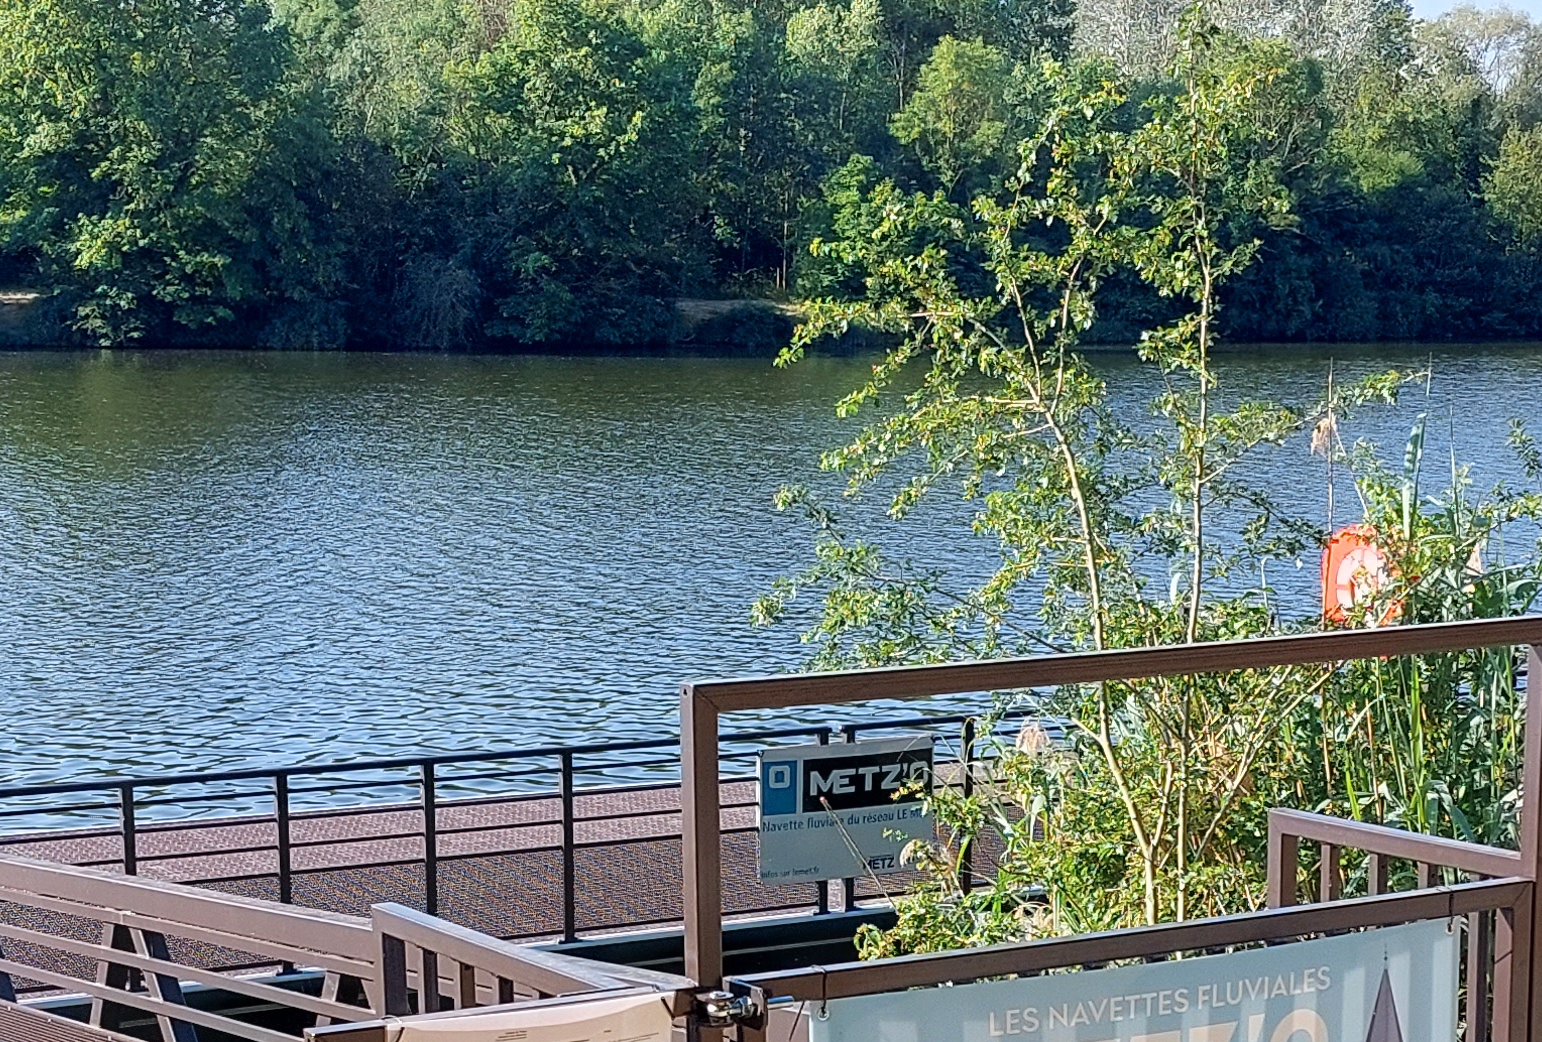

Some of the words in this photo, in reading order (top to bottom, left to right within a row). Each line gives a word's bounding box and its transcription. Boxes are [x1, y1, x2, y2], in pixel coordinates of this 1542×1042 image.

[810, 761, 928, 796] METZ'O
[762, 820, 804, 833] Navette
[807, 816, 845, 829] fluviae
[847, 814, 860, 826] du
[863, 811, 894, 824] réseau
[897, 808, 908, 820] LE
[989, 1007, 1040, 1037] LES
[1049, 988, 1190, 1030] NAVETTES
[1197, 966, 1332, 1010] FLUVIALES
